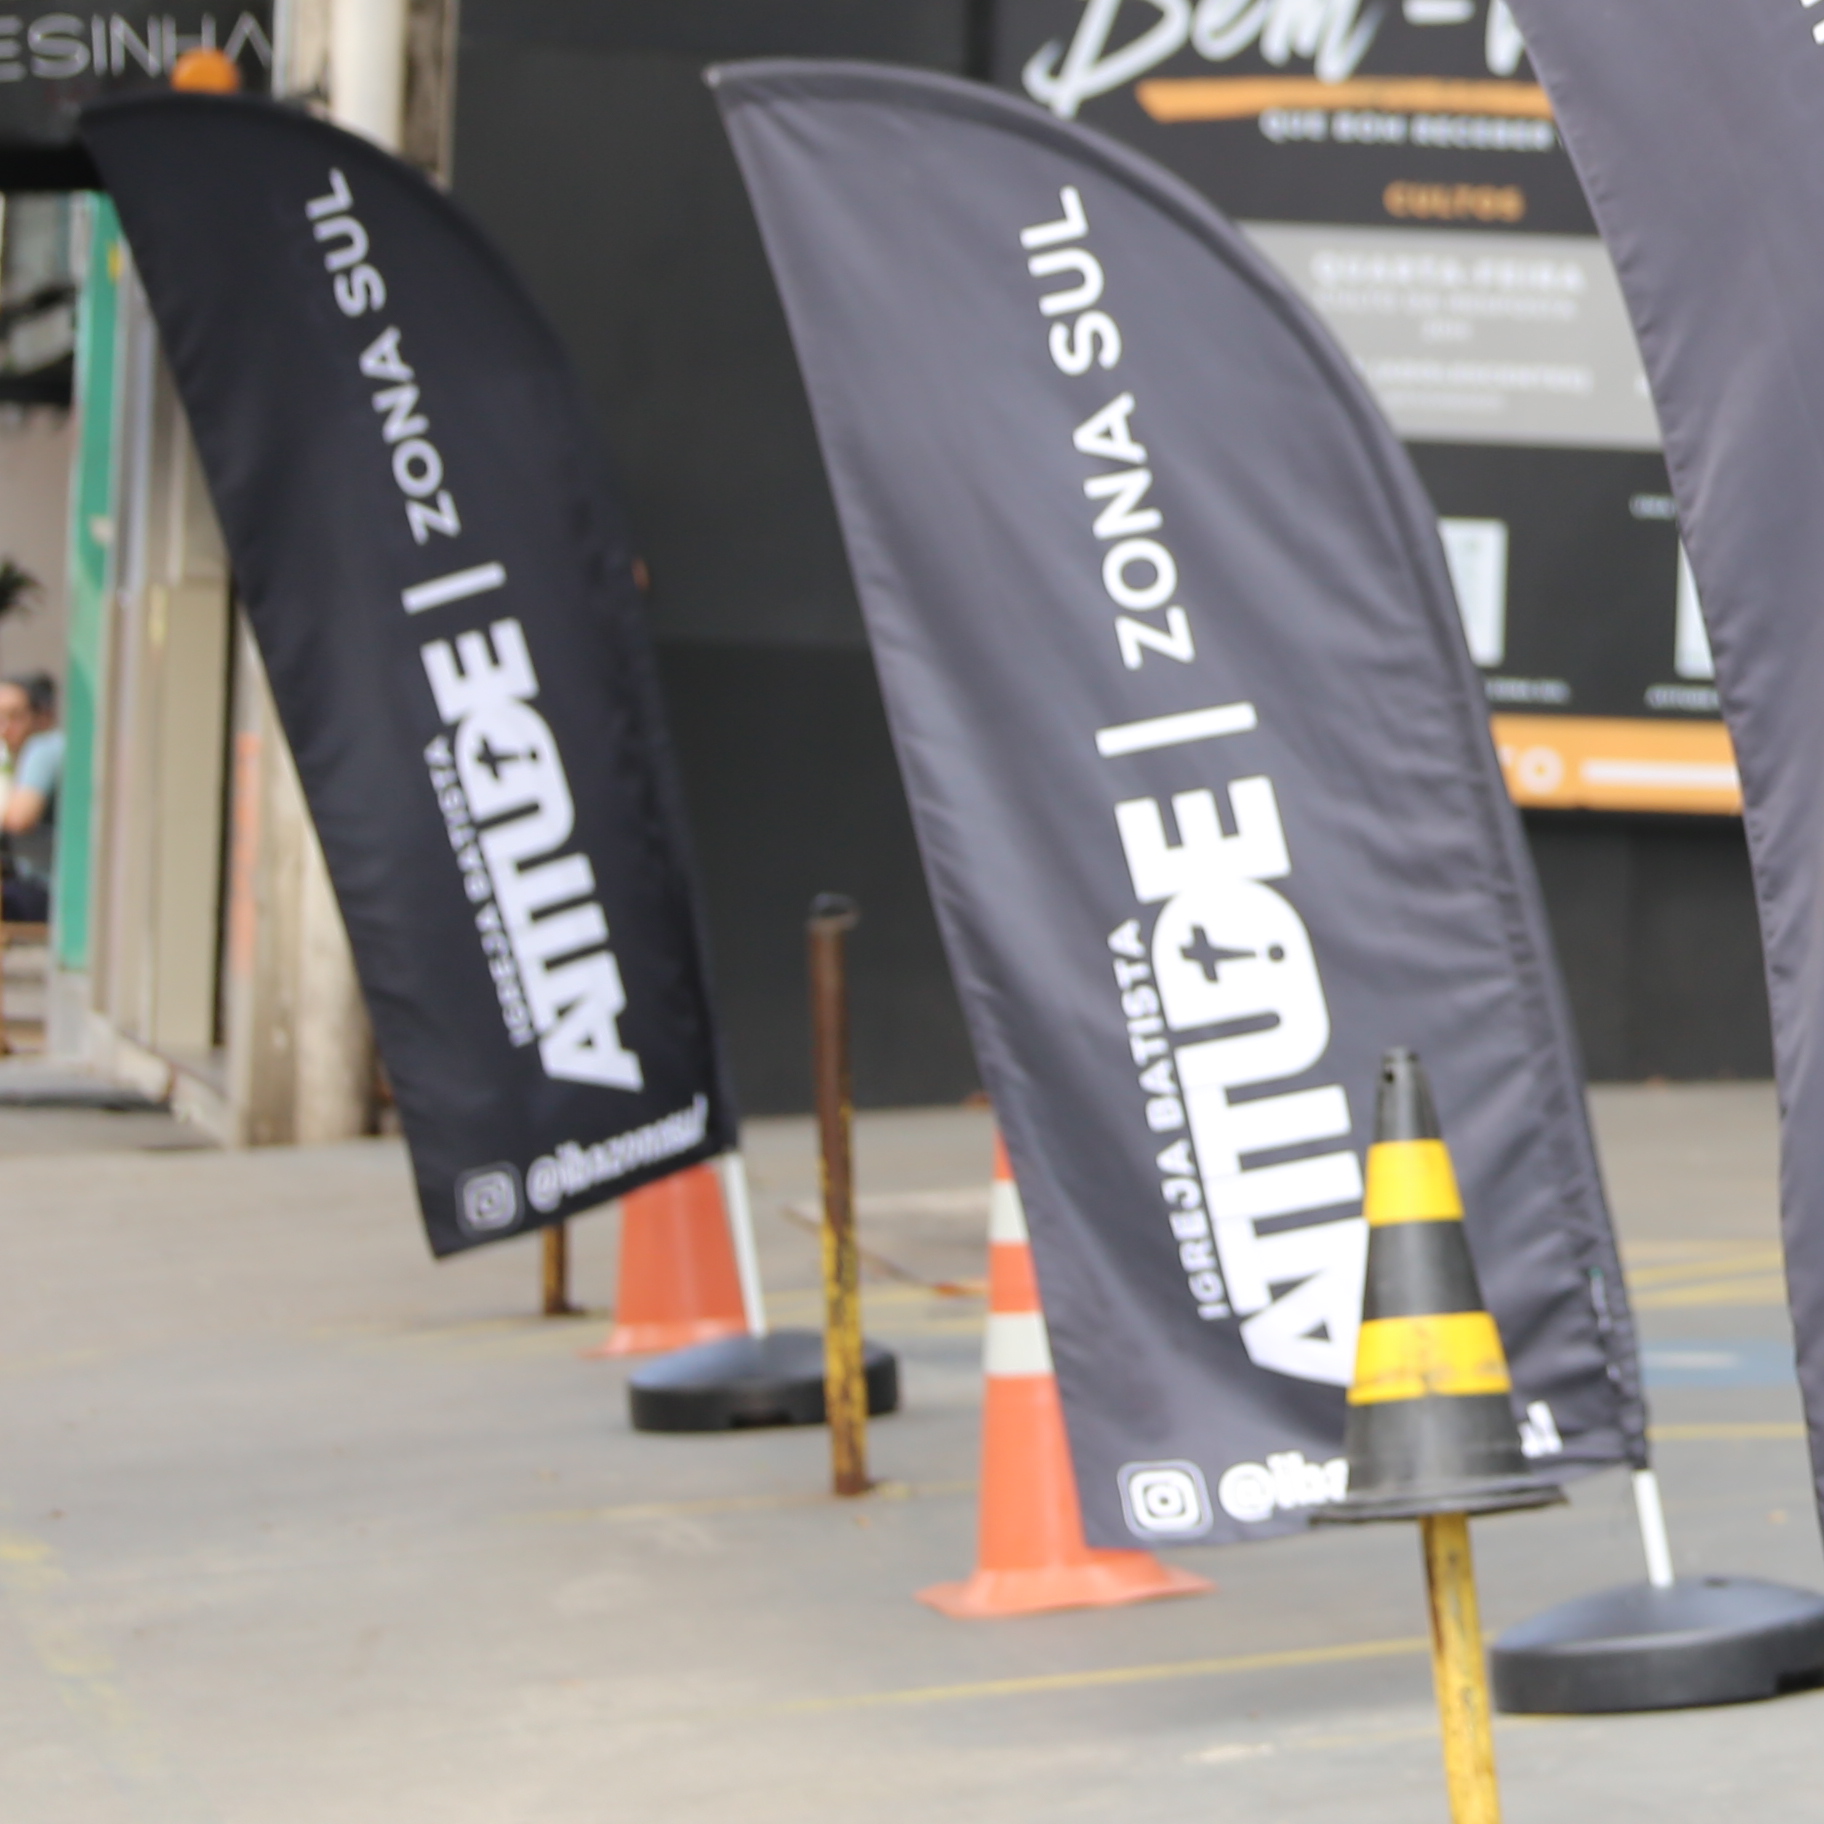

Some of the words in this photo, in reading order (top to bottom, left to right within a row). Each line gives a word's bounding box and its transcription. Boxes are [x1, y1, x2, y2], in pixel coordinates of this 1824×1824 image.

[305, 168, 388, 317] SUL
[1020, 186, 1122, 375] SUL
[359, 326, 462, 545] ZONA
[1072, 392, 1195, 670] ZONA
[420, 618, 643, 1092] ATITUDE
[1106, 918, 1186, 1133] BATISTA
[1114, 775, 1370, 1389] ATITUDE
[1155, 1137, 1230, 1320] IGREJA
